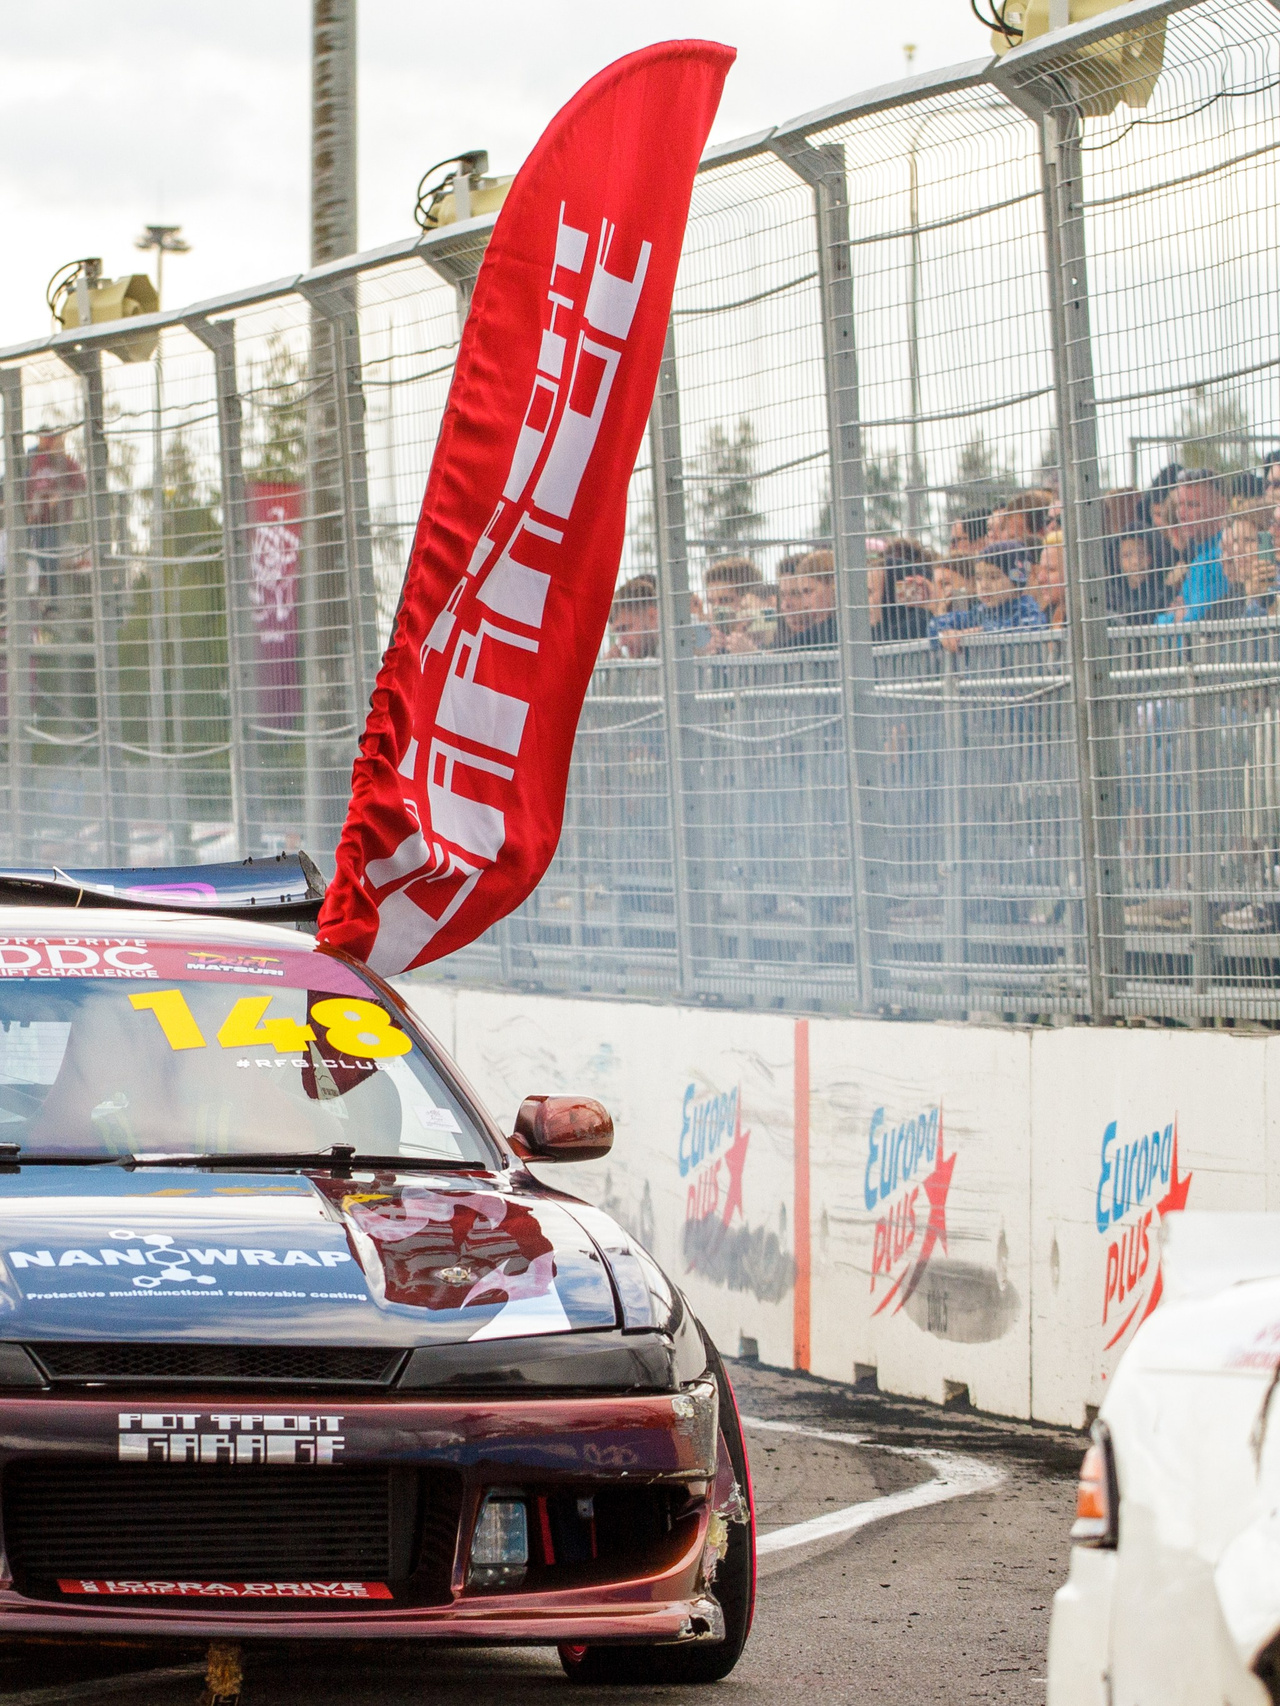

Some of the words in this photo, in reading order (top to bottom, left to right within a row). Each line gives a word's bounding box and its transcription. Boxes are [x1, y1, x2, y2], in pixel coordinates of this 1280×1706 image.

[64, 938, 148, 947] DRIVE
[35, 967, 160, 979] CHALLENGE
[186, 963, 285, 976] MATSURI
[127, 989, 413, 1059] 148
[678, 1082, 738, 1179] Europa
[864, 1106, 939, 1212] Europa
[1096, 1120, 1173, 1235] Europa
[26, 1290, 106, 1300] Protective
[108, 1288, 224, 1298] multifunctional
[227, 1289, 307, 1299] removable
[309, 1290, 368, 1301] coating
[118, 1433, 346, 1465] GARAGE
[104, 1580, 236, 1591] IGORA
[243, 1582, 364, 1591] DRIVE
[198, 1588, 370, 1597] CHALLENGE
